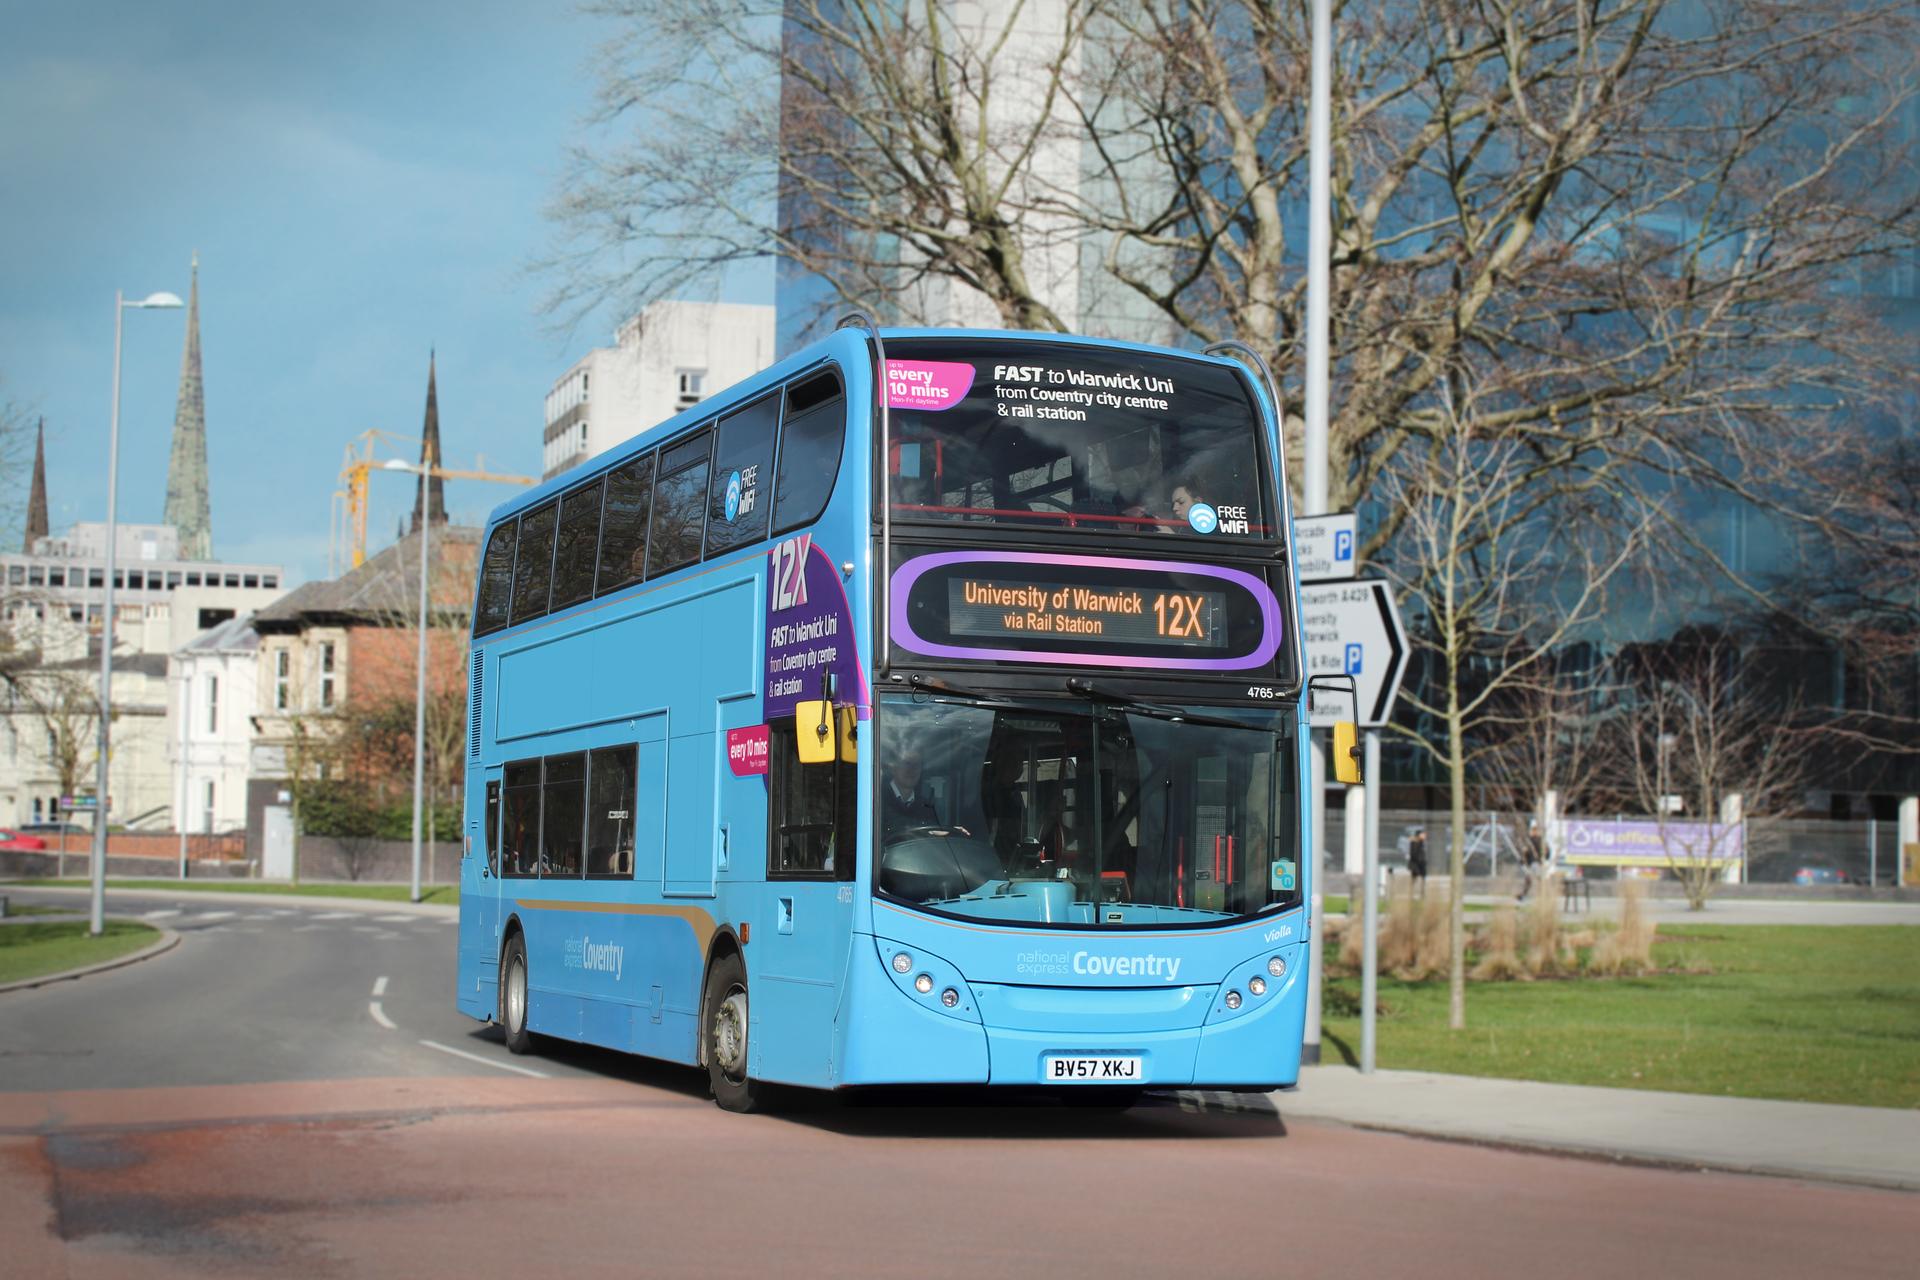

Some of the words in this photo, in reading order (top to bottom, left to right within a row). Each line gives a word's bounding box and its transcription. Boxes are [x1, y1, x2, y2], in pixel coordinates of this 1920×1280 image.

[889, 369, 933, 384] every
[994, 365, 1044, 382] FAST
[1047, 370, 1065, 384] to
[1067, 369, 1142, 391] Warwick
[1144, 376, 1175, 394] Uni
[890, 382, 907, 395] 10
[911, 384, 949, 398] mins
[915, 397, 940, 405] daytime
[995, 385, 1028, 399] from
[1030, 387, 1093, 407] Coventry
[1096, 392, 1121, 409] city
[1124, 396, 1169, 410] centre
[997, 403, 1009, 417] &
[1011, 404, 1034, 418] rail
[1036, 406, 1087, 421] station
[741, 464, 758, 488] FREE
[738, 489, 756, 516] WIFI
[1217, 505, 1247, 519] FREE
[1218, 519, 1249, 534] WIFI
[772, 532, 812, 612] 12X
[965, 581, 1048, 613] University
[1053, 588, 1069, 609] of
[1073, 588, 1142, 614] Warwick
[1341, 588, 1369, 602] A429
[1004, 612, 1024, 629] via
[1027, 613, 1052, 631] Rail
[1056, 615, 1102, 634] Station
[1154, 594, 1204, 638] 12X
[771, 625, 789, 648] FAST
[789, 626, 796, 644] to
[796, 615, 824, 642] Warwick
[824, 612, 837, 636] Uni
[769, 656, 782, 673] from
[782, 652, 807, 671] Coventry
[807, 648, 817, 669] city
[817, 646, 837, 664] centre
[1321, 654, 1341, 669] Ride
[773, 678, 783, 697] rail
[783, 675, 803, 695] station
[1247, 687, 1274, 699] 4765
[730, 743, 747, 762] every
[747, 738, 754, 757] 10
[754, 737, 767, 756] mins
[837, 886, 853, 903] 4765
[583, 935, 624, 981] Coventry
[1017, 950, 1070, 964] national
[1073, 951, 1181, 981] Coventry
[1017, 963, 1069, 976] express
[1055, 1060, 1098, 1077] BV57
[1102, 1060, 1134, 1077] XKJ
